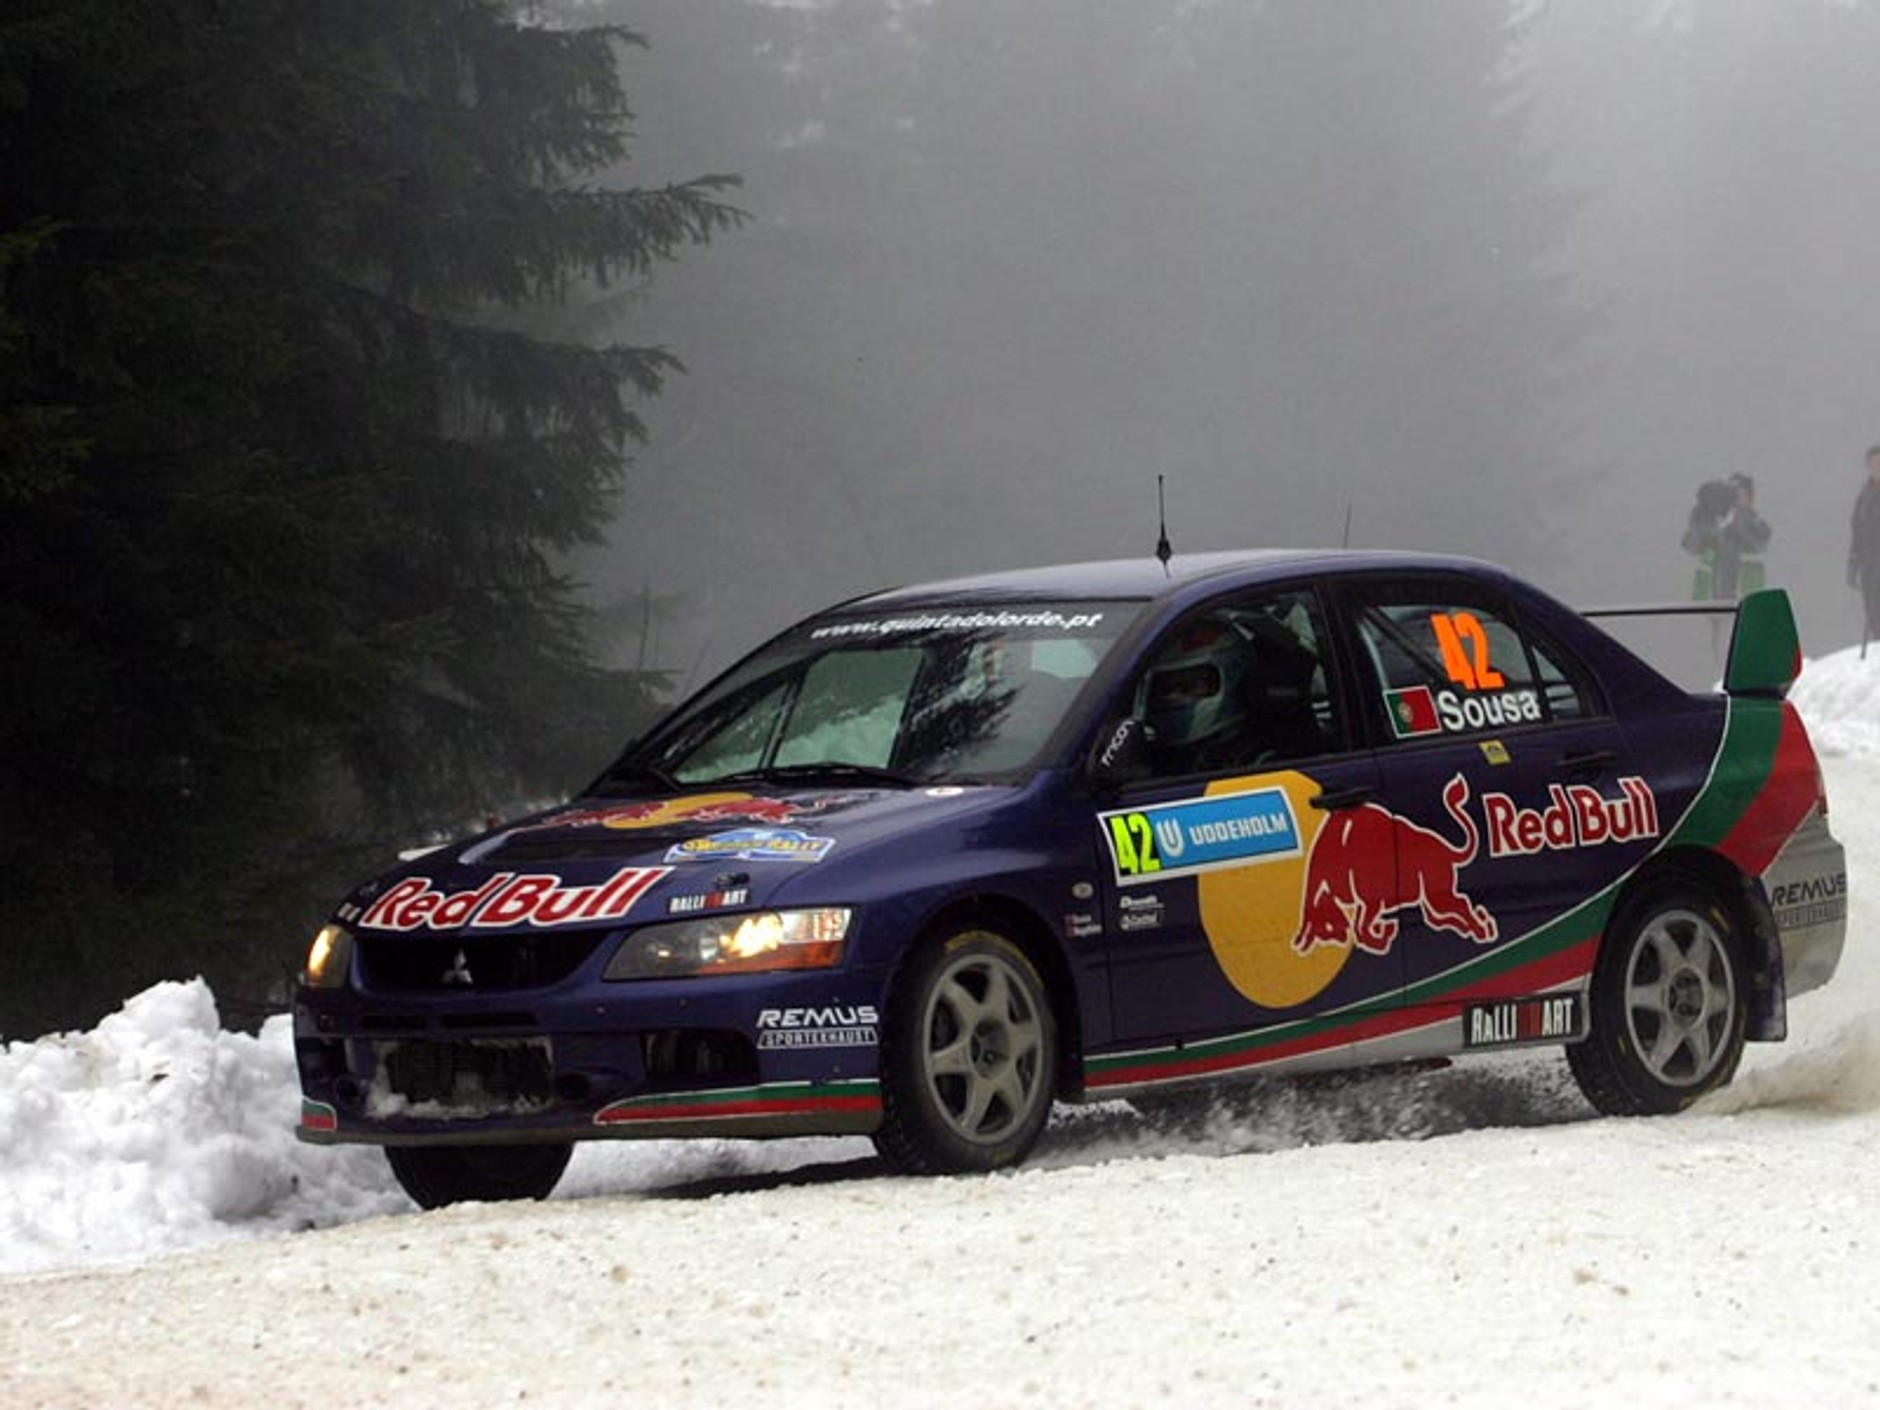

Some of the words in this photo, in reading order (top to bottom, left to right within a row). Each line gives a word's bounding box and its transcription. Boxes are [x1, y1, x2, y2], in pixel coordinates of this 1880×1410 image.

[1430, 612, 1505, 690] 42
[1438, 690, 1541, 731] Sousa
[1189, 813, 1289, 845] UDDEHOLM
[1482, 784, 1575, 857] Red
[1566, 776, 1658, 846] Bull
[1110, 812, 1162, 875] 42
[358, 871, 514, 931] Red
[470, 866, 677, 927] Bull
[1772, 872, 1847, 907] REMUS
[757, 1005, 878, 1028] REMUS
